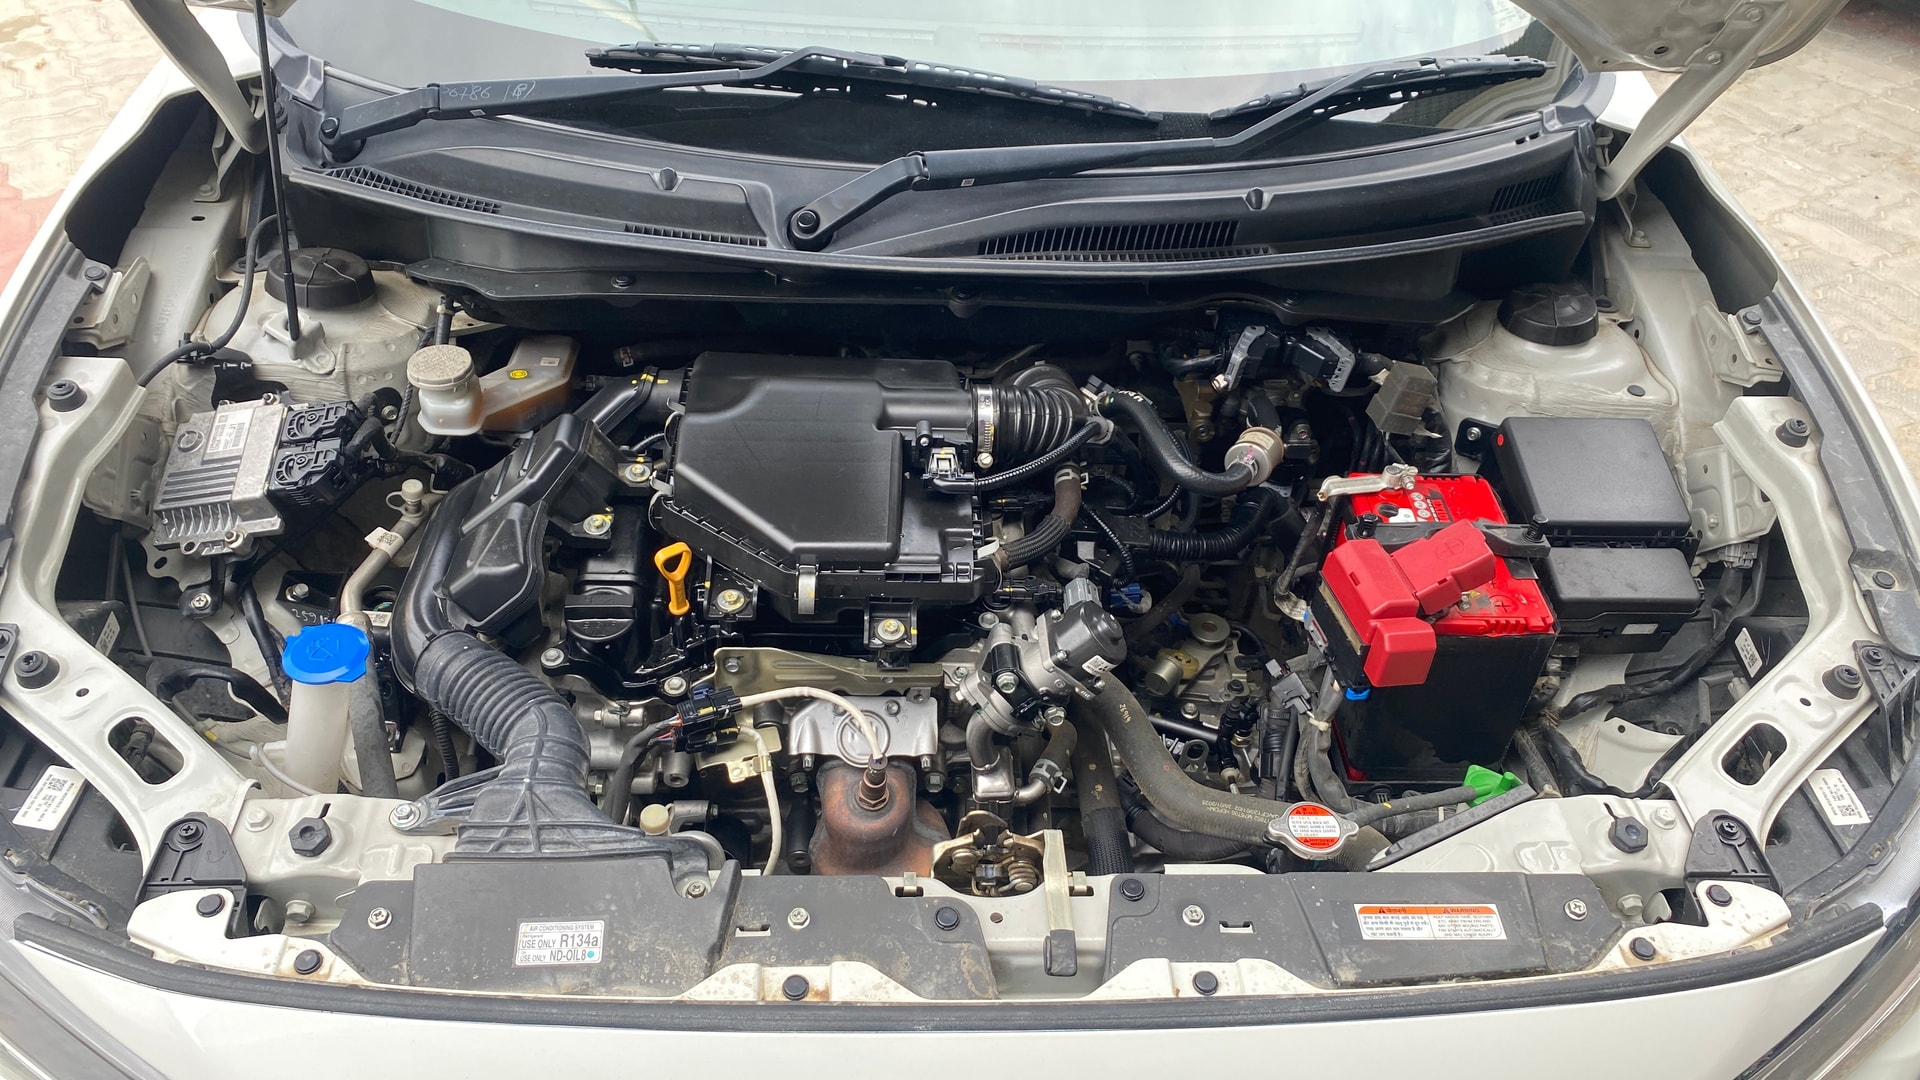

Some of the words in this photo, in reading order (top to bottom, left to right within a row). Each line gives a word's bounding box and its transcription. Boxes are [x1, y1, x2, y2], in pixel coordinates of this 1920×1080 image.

[521, 940, 536, 948] USE
[538, 939, 556, 948] ONLY
[560, 933, 599, 947] R134a
[550, 949, 586, 961] ND-OIL8
